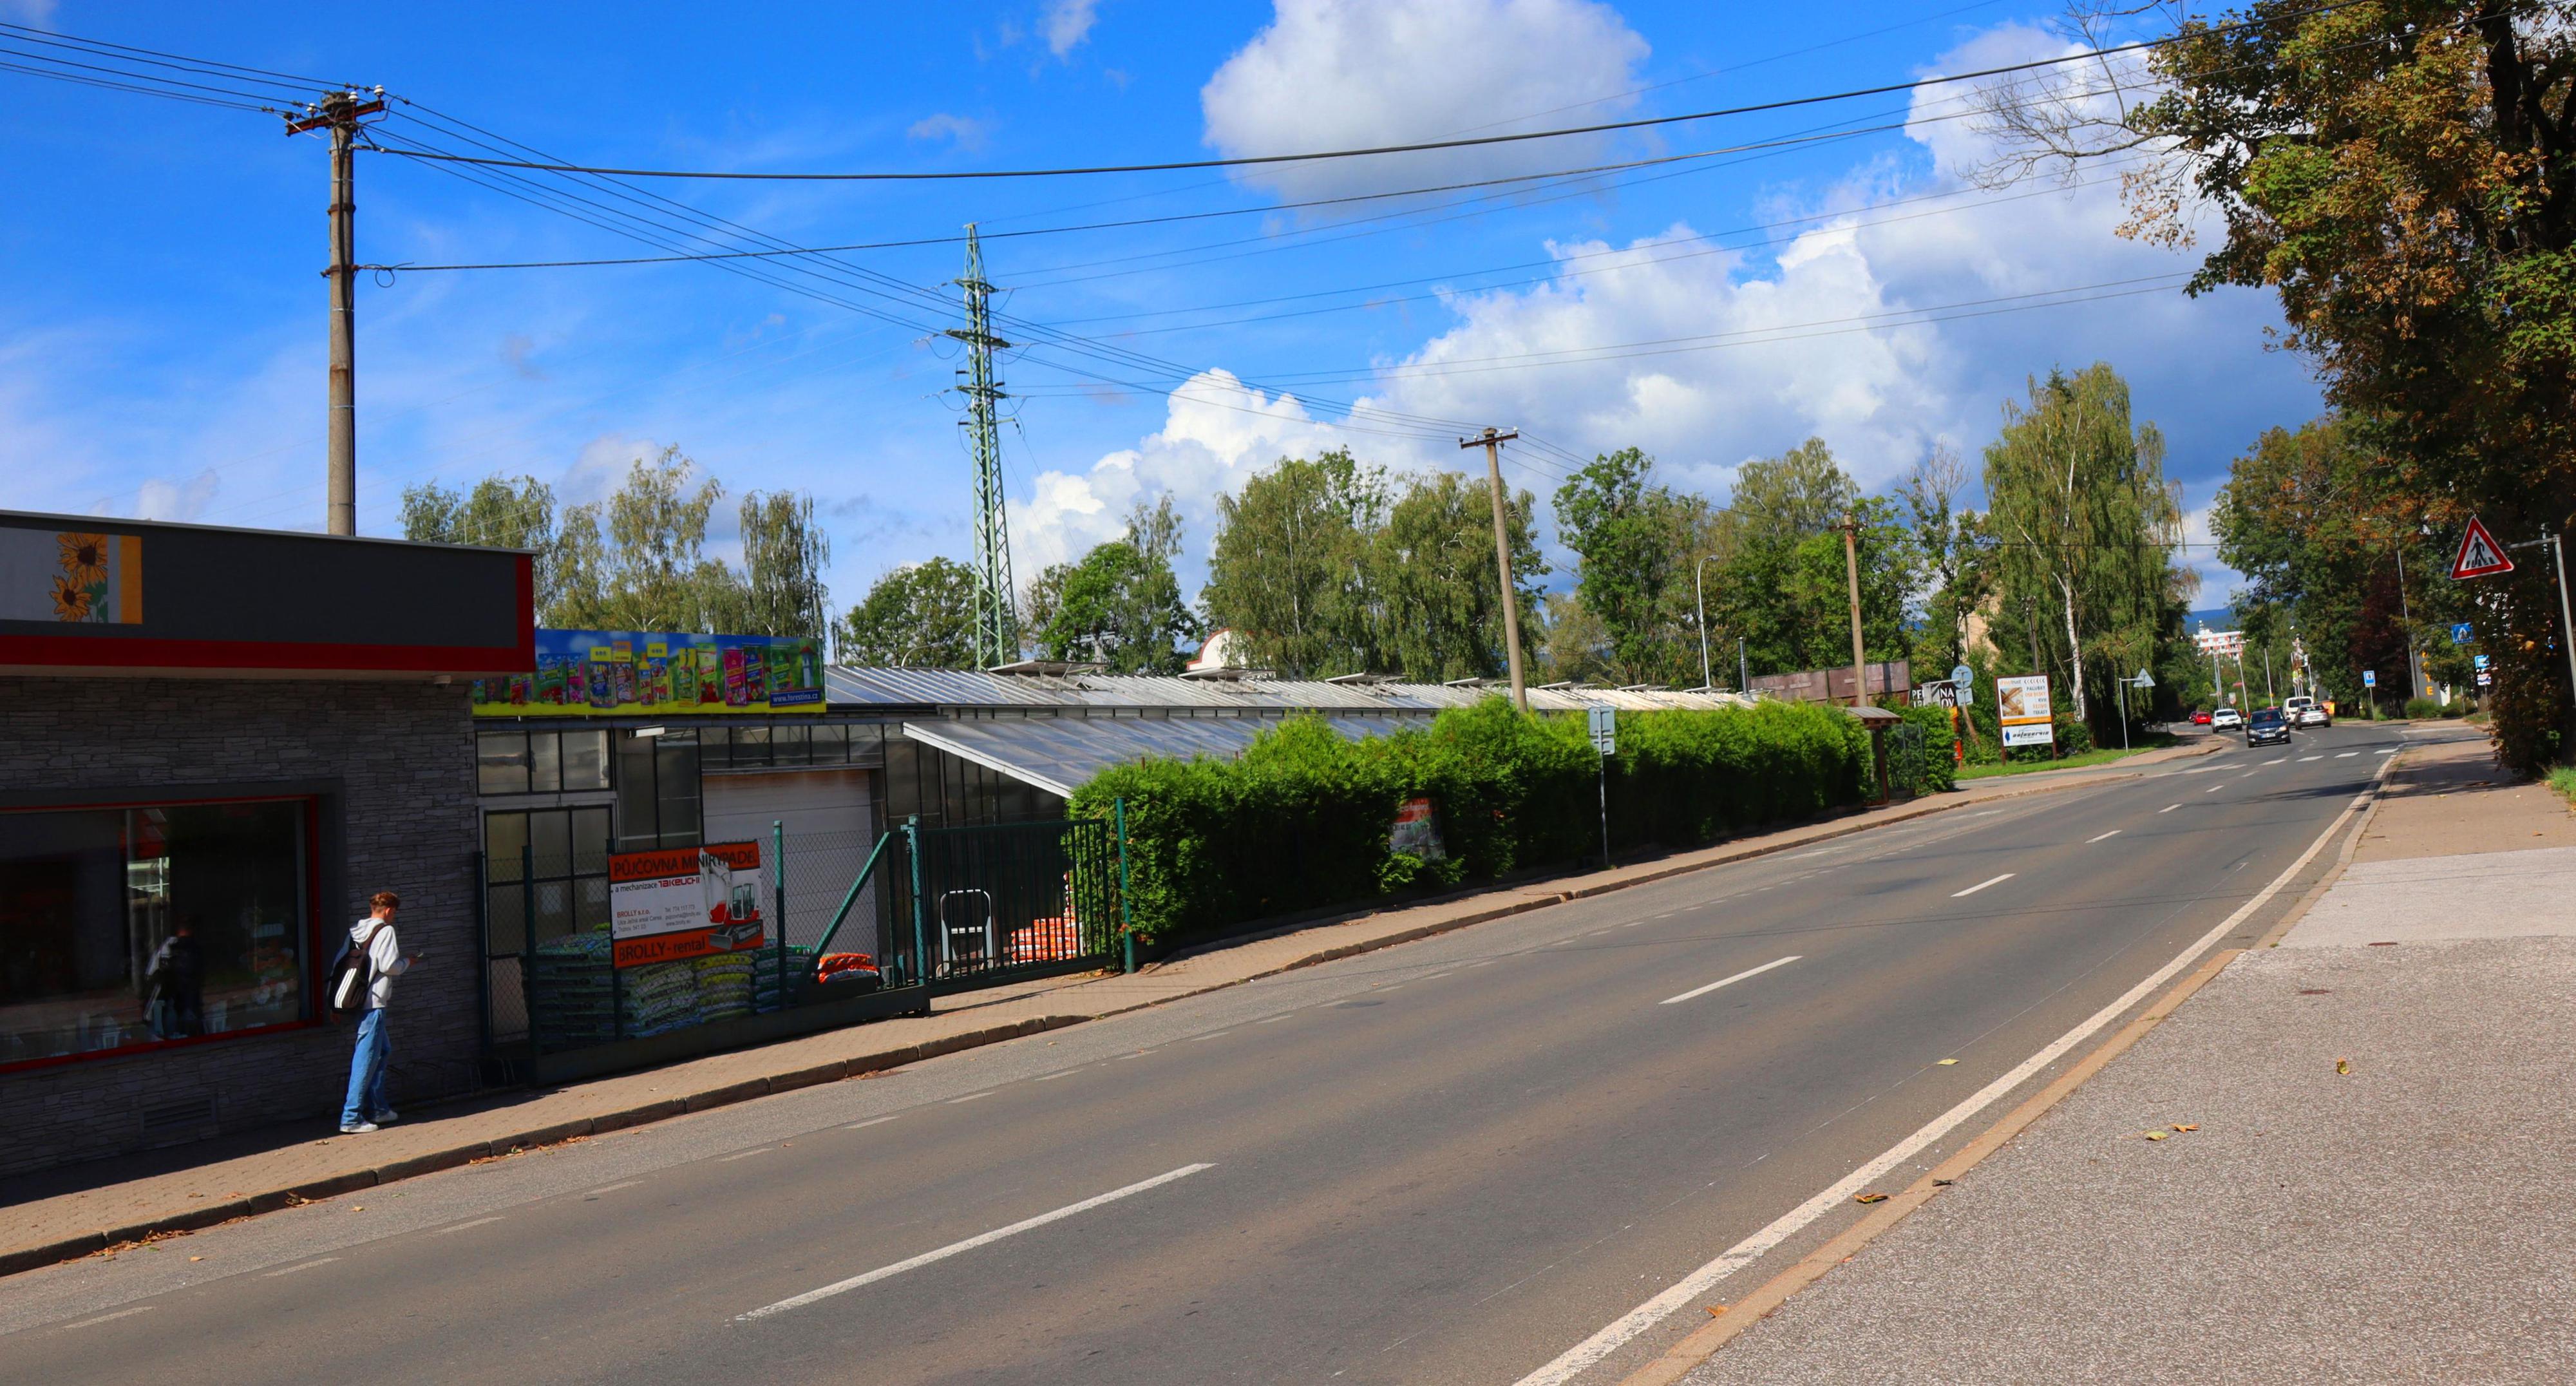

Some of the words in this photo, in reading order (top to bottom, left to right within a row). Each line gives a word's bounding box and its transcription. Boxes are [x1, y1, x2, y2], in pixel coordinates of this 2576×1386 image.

[773, 693, 818, 703] www.forestina.cz
[614, 857, 678, 876] PŮJČOVNA
[620, 882, 657, 892] mechanizace
[658, 877, 699, 888] TAKEUCHI
[617, 910, 637, 918] BROLLY
[619, 942, 665, 962] BROLLY
[674, 936, 705, 953] rental
